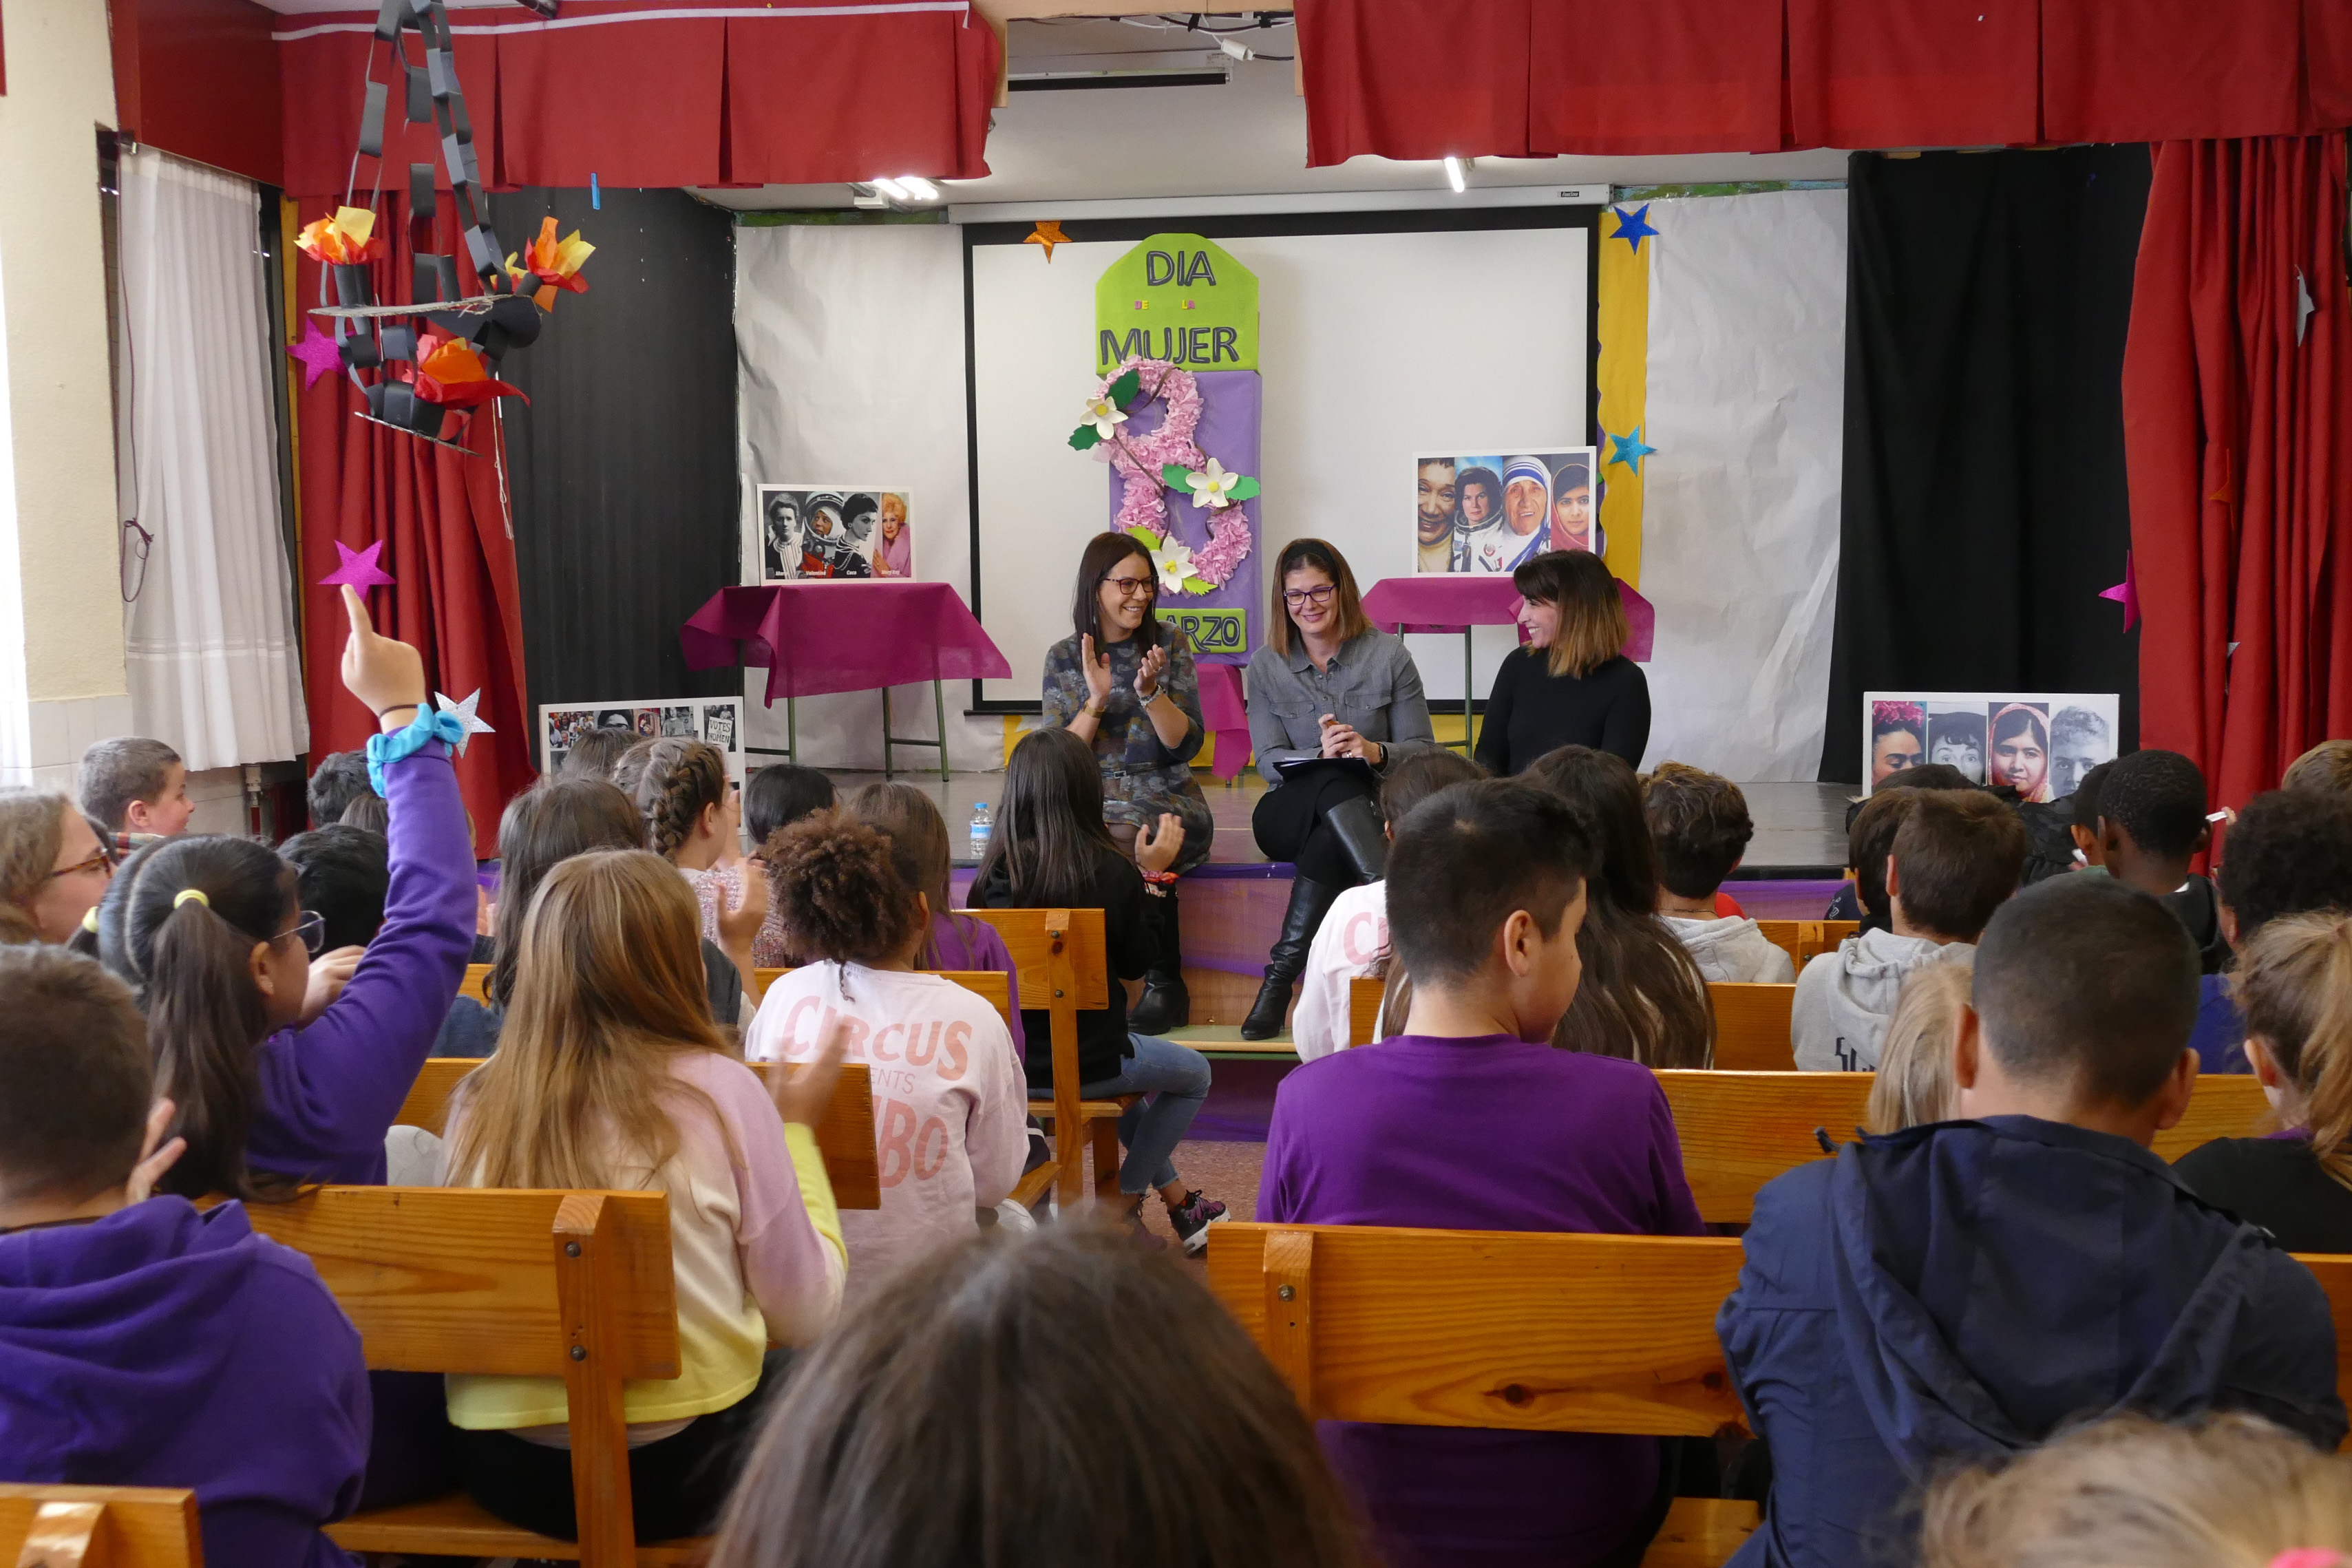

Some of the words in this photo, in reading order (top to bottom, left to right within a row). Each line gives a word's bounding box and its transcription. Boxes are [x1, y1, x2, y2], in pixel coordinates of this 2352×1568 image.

[1146, 250, 1217, 286] DIA
[1134, 300, 1148, 310] DE
[1181, 299, 1195, 309] LA
[1100, 326, 1240, 365] MUJER
[1166, 615, 1241, 653] RZO
[708, 732, 730, 743] WOMEN
[710, 719, 731, 732] VOTES
[781, 995, 973, 1081] CIRCUS
